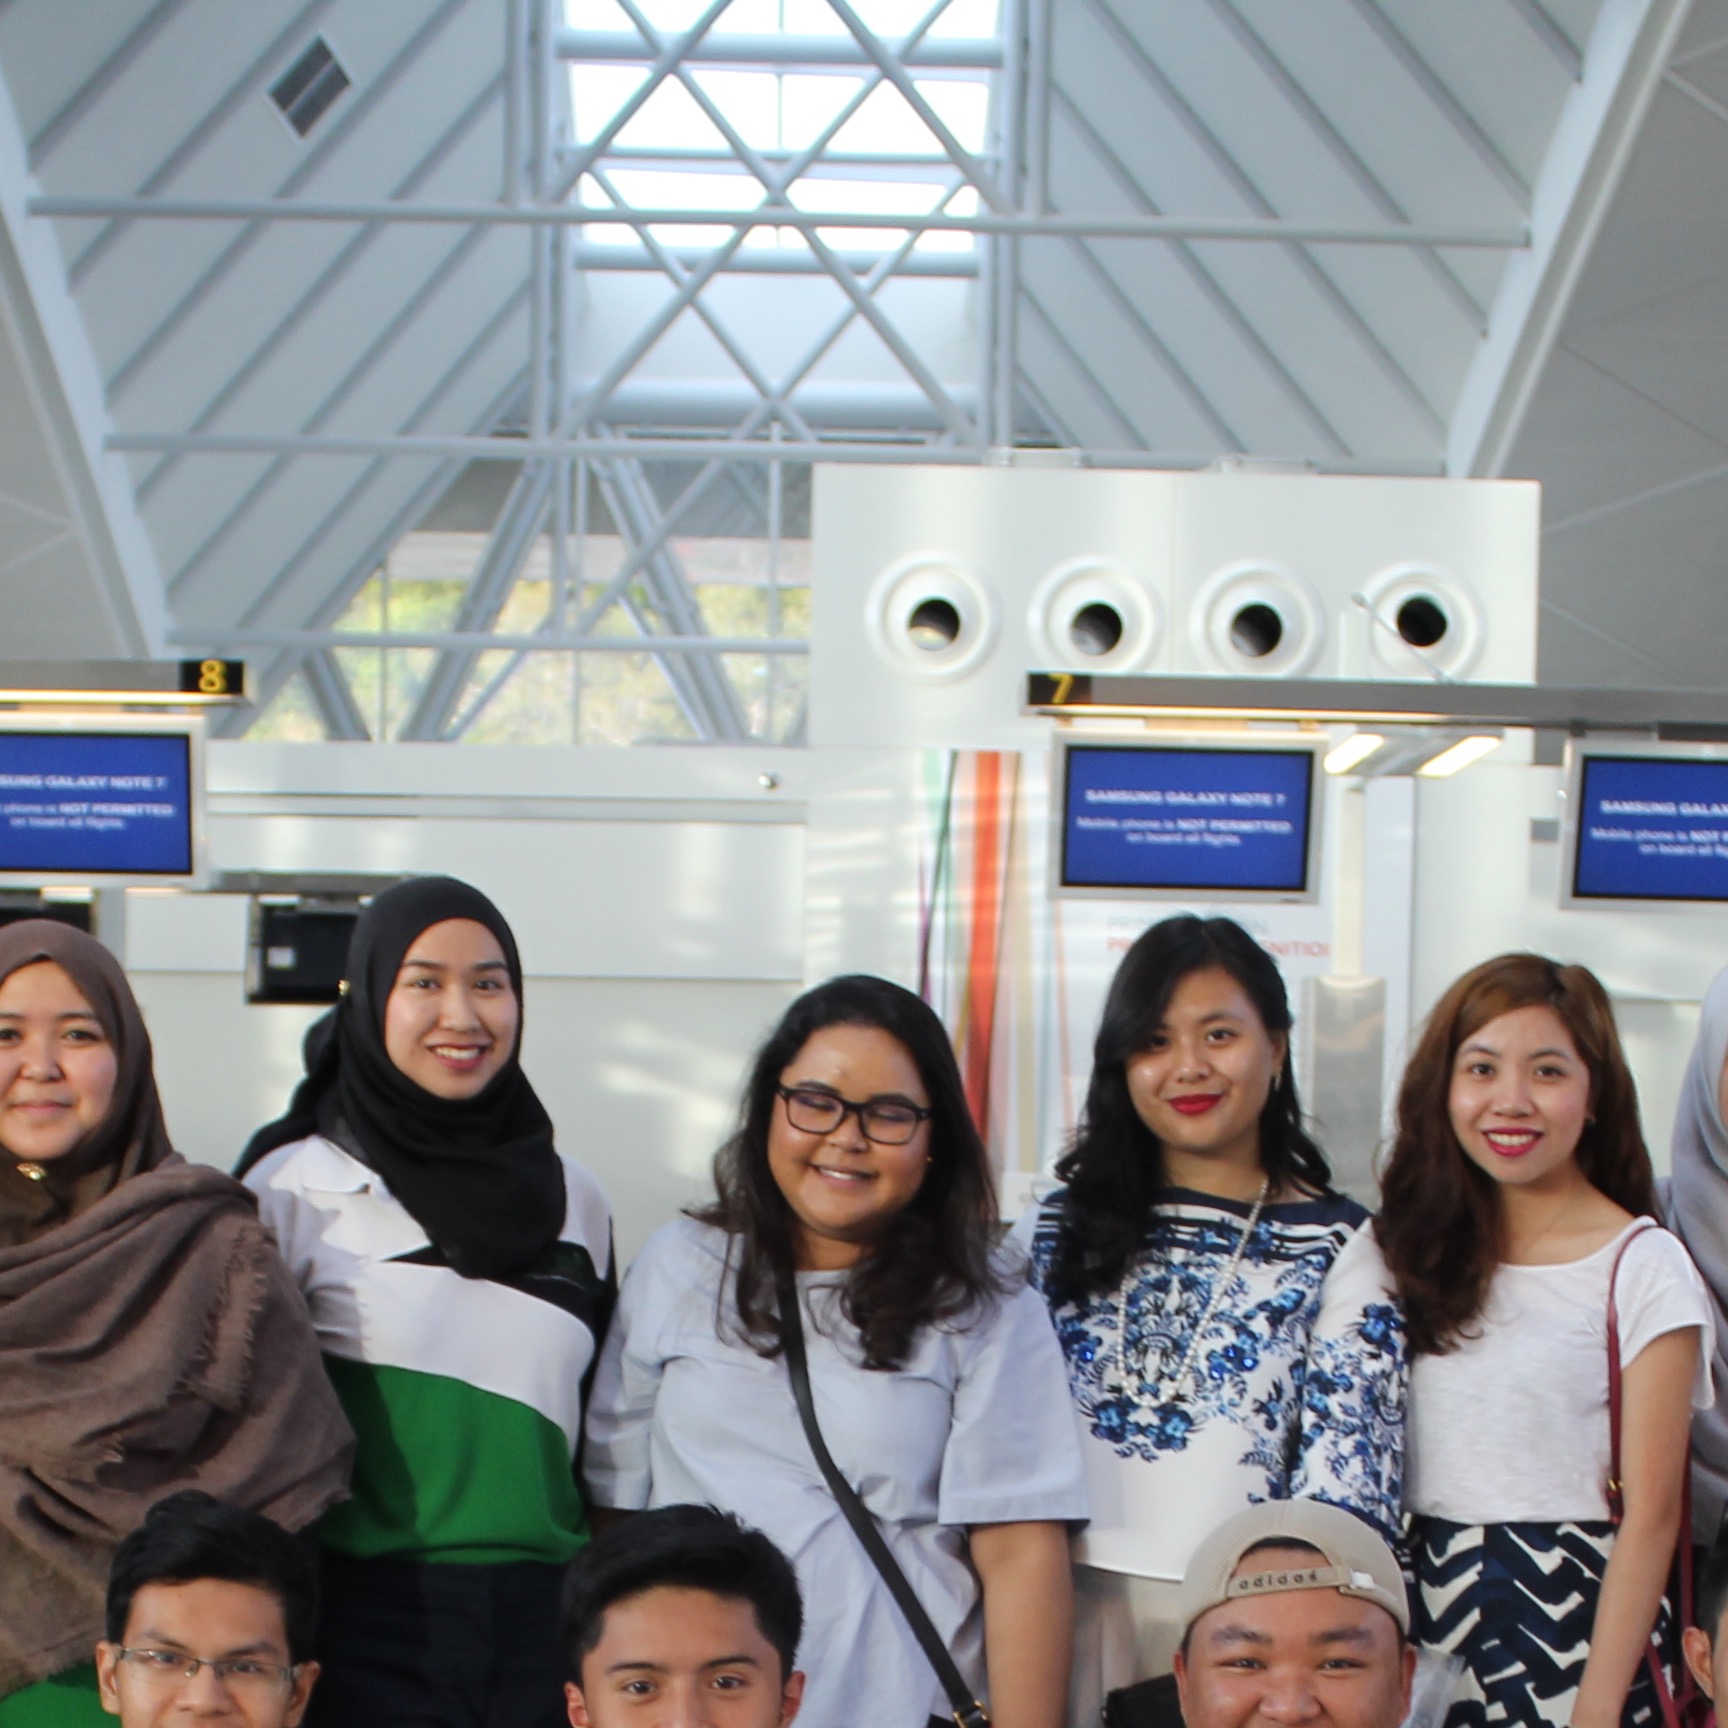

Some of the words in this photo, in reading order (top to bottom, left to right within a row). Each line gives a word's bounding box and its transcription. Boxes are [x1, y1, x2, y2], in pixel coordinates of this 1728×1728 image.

[198, 659, 225, 692] 8
[1048, 673, 1072, 704] 7
[45, 775, 106, 790] GALAXY
[110, 776, 153, 791] NOTE
[1085, 788, 1162, 804] SAMSUNG
[1165, 790, 1226, 805] GALAXY
[1230, 791, 1273, 807] NOTE
[1600, 799, 1676, 816] SAMSUNG
[1176, 818, 1207, 832] NOT
[1689, 829, 1720, 844] NOT
[1238, 1570, 1318, 1590] adidas
